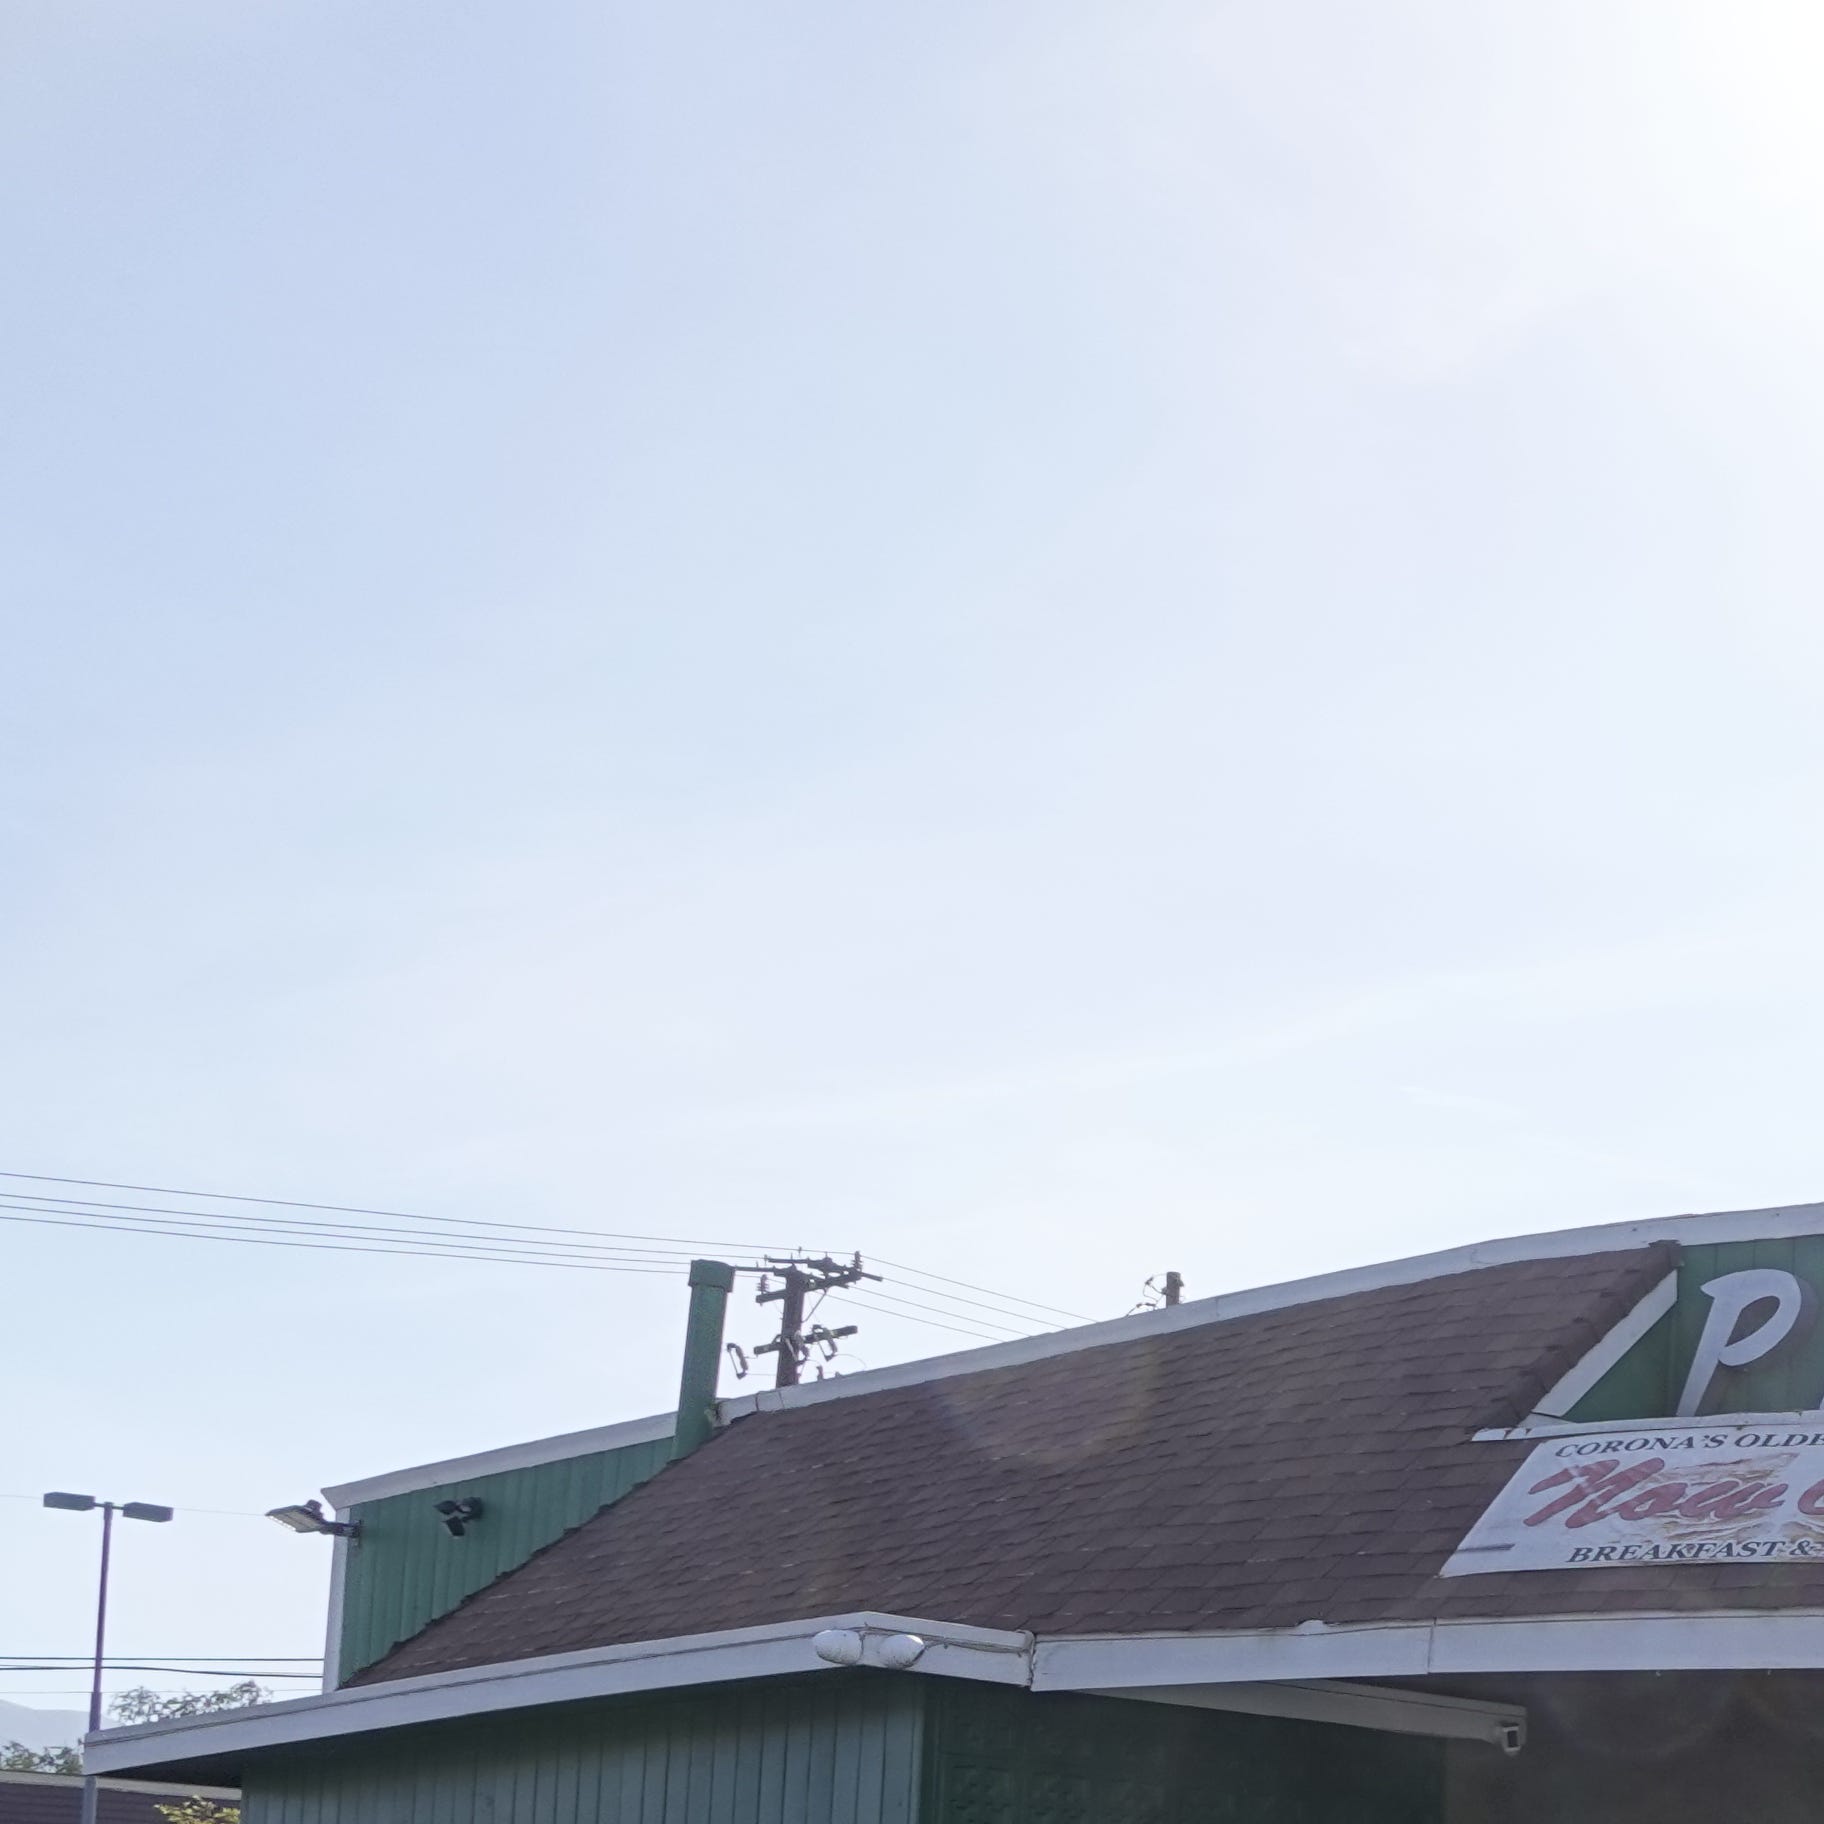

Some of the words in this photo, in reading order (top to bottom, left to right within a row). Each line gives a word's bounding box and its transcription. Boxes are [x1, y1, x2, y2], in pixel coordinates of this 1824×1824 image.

[1554, 1433, 1728, 1458] CORONA'S
[1523, 1456, 1790, 1529] Now
[1566, 1541, 1787, 1563] BREAKFAST
